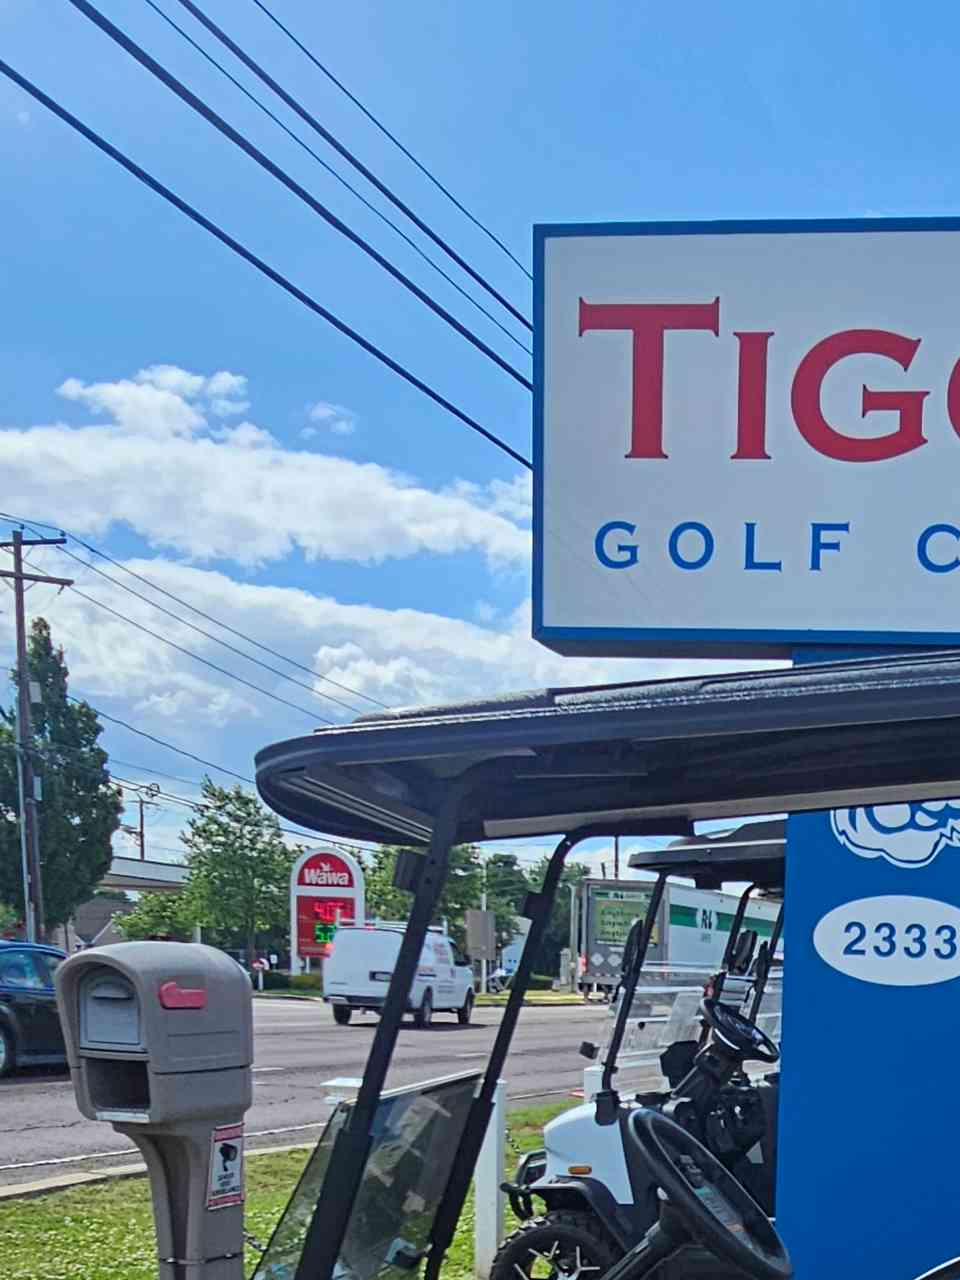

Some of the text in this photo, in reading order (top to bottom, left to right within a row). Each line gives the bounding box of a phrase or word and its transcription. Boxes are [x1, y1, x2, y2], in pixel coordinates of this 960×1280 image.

[594, 520, 850, 572] GOLF
[304, 868, 349, 885] Wawa
[843, 921, 958, 961] 2333
